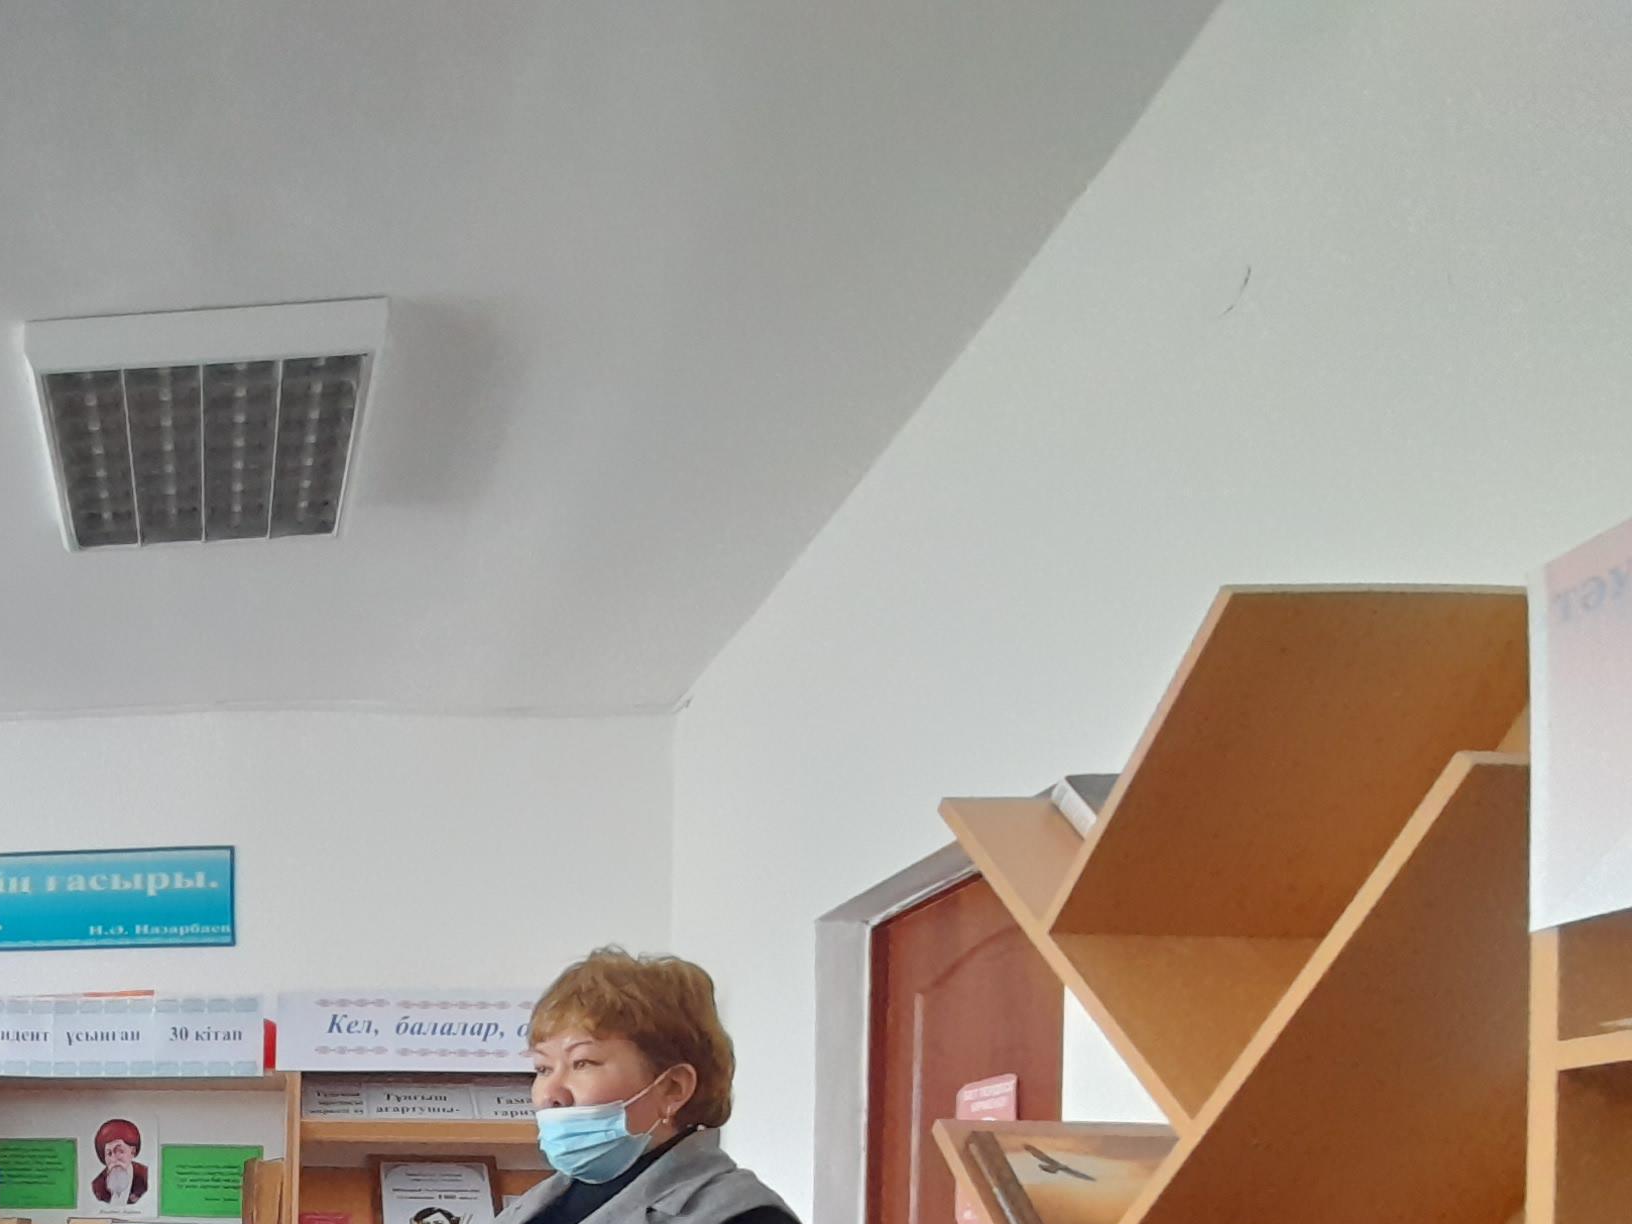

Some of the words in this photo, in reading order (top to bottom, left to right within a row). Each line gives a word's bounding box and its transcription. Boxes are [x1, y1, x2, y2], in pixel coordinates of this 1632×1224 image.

[169, 1026, 189, 1042] 30
[195, 1025, 243, 1042] кітап
[327, 1013, 380, 1036] Кел,
[395, 1016, 505, 1042] балалар,
